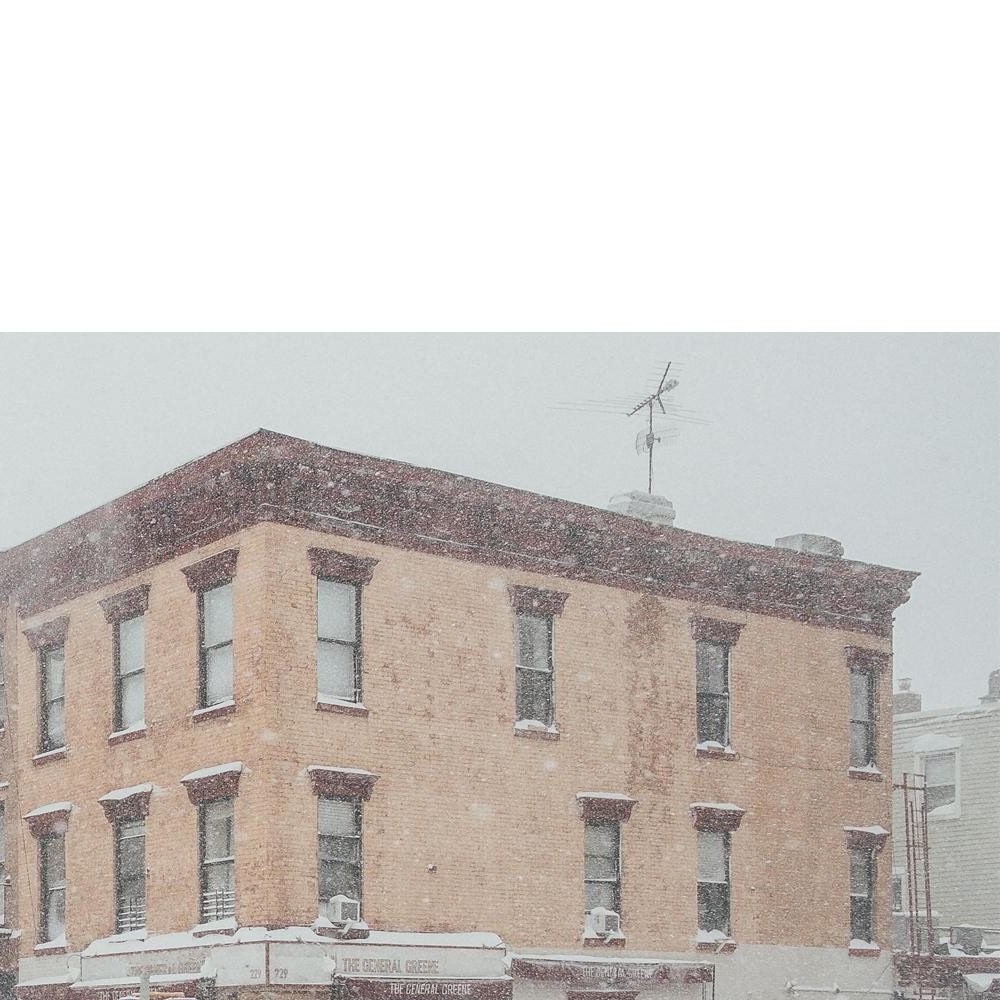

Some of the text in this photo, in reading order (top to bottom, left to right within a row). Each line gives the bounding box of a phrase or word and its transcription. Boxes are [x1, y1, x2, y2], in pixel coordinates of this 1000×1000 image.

[342, 958, 439, 974] THE GENERAL GREENE
[274, 968, 289, 979] 229
[390, 982, 472, 995] THE GENERAL GREENE
